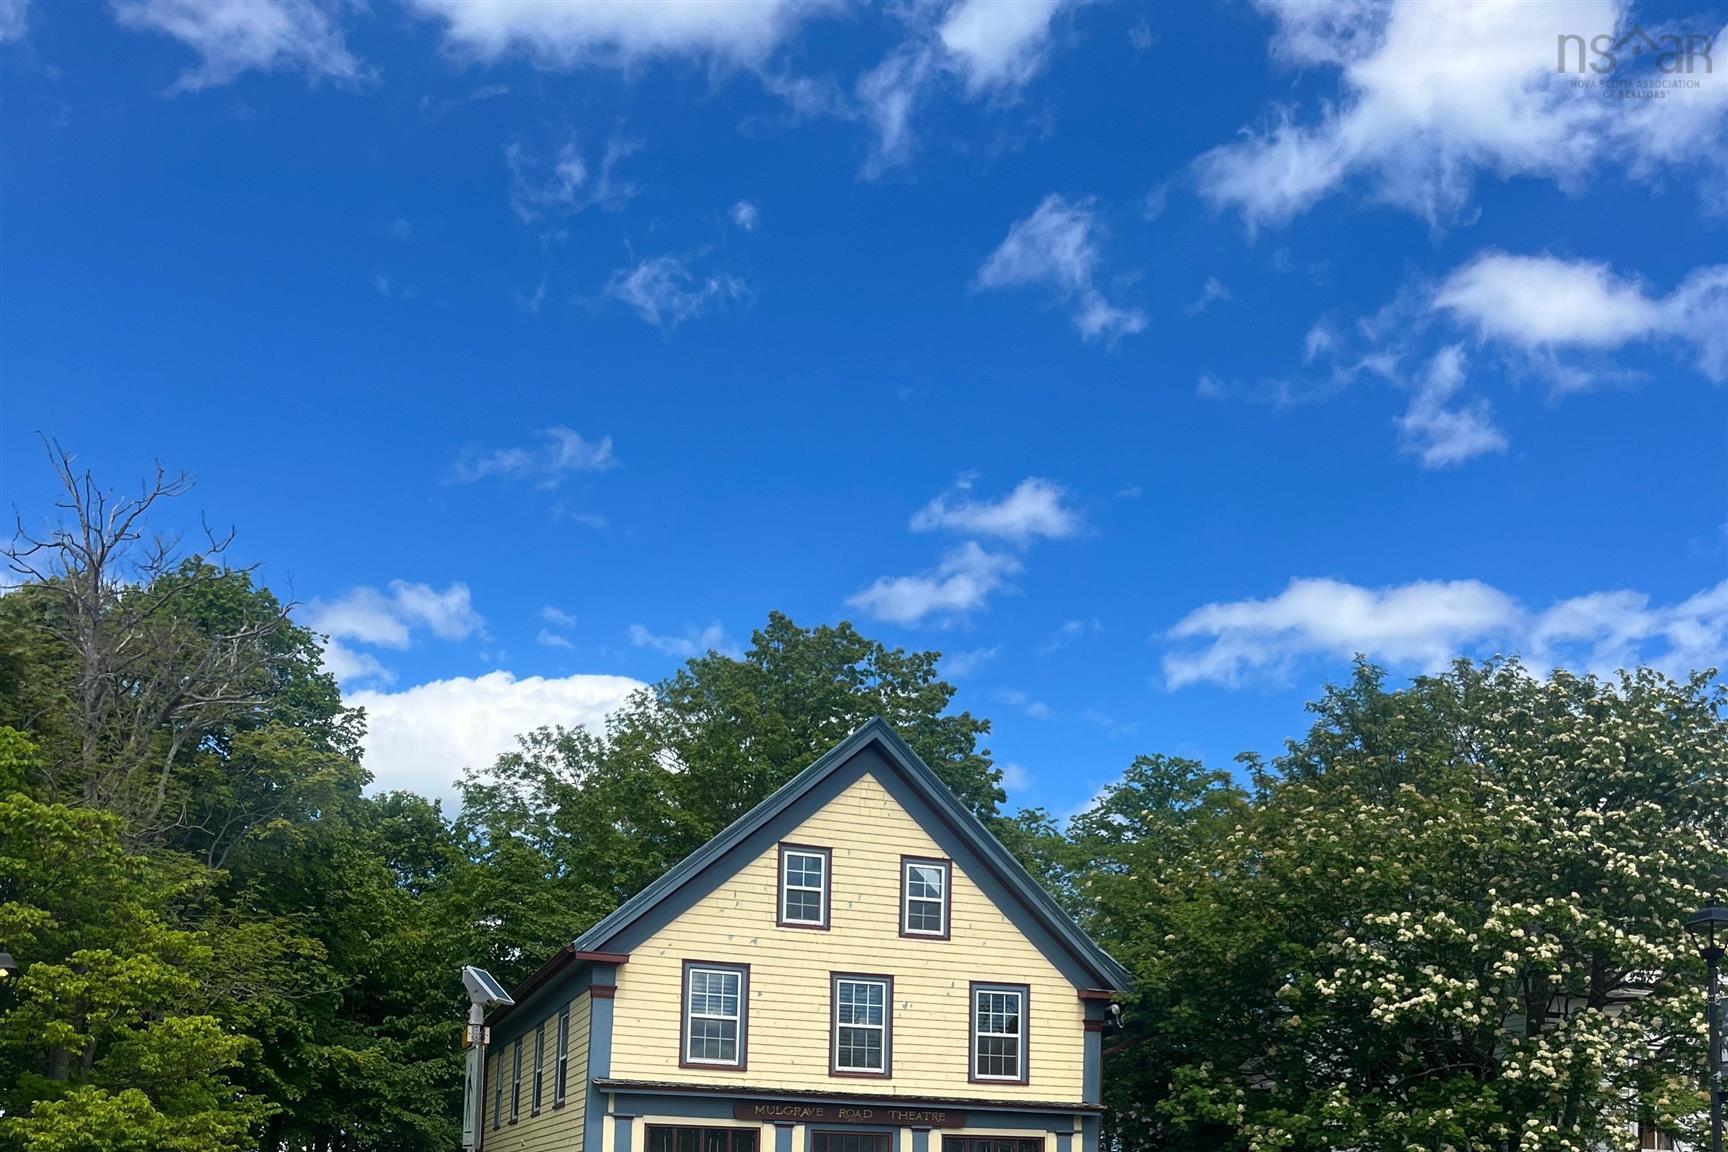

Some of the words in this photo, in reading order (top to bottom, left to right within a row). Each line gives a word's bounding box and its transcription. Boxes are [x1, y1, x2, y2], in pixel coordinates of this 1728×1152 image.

[754, 1104, 824, 1118] MULGRAVE
[838, 1108, 873, 1119] ROAD
[888, 1110, 946, 1122] THEATRE
